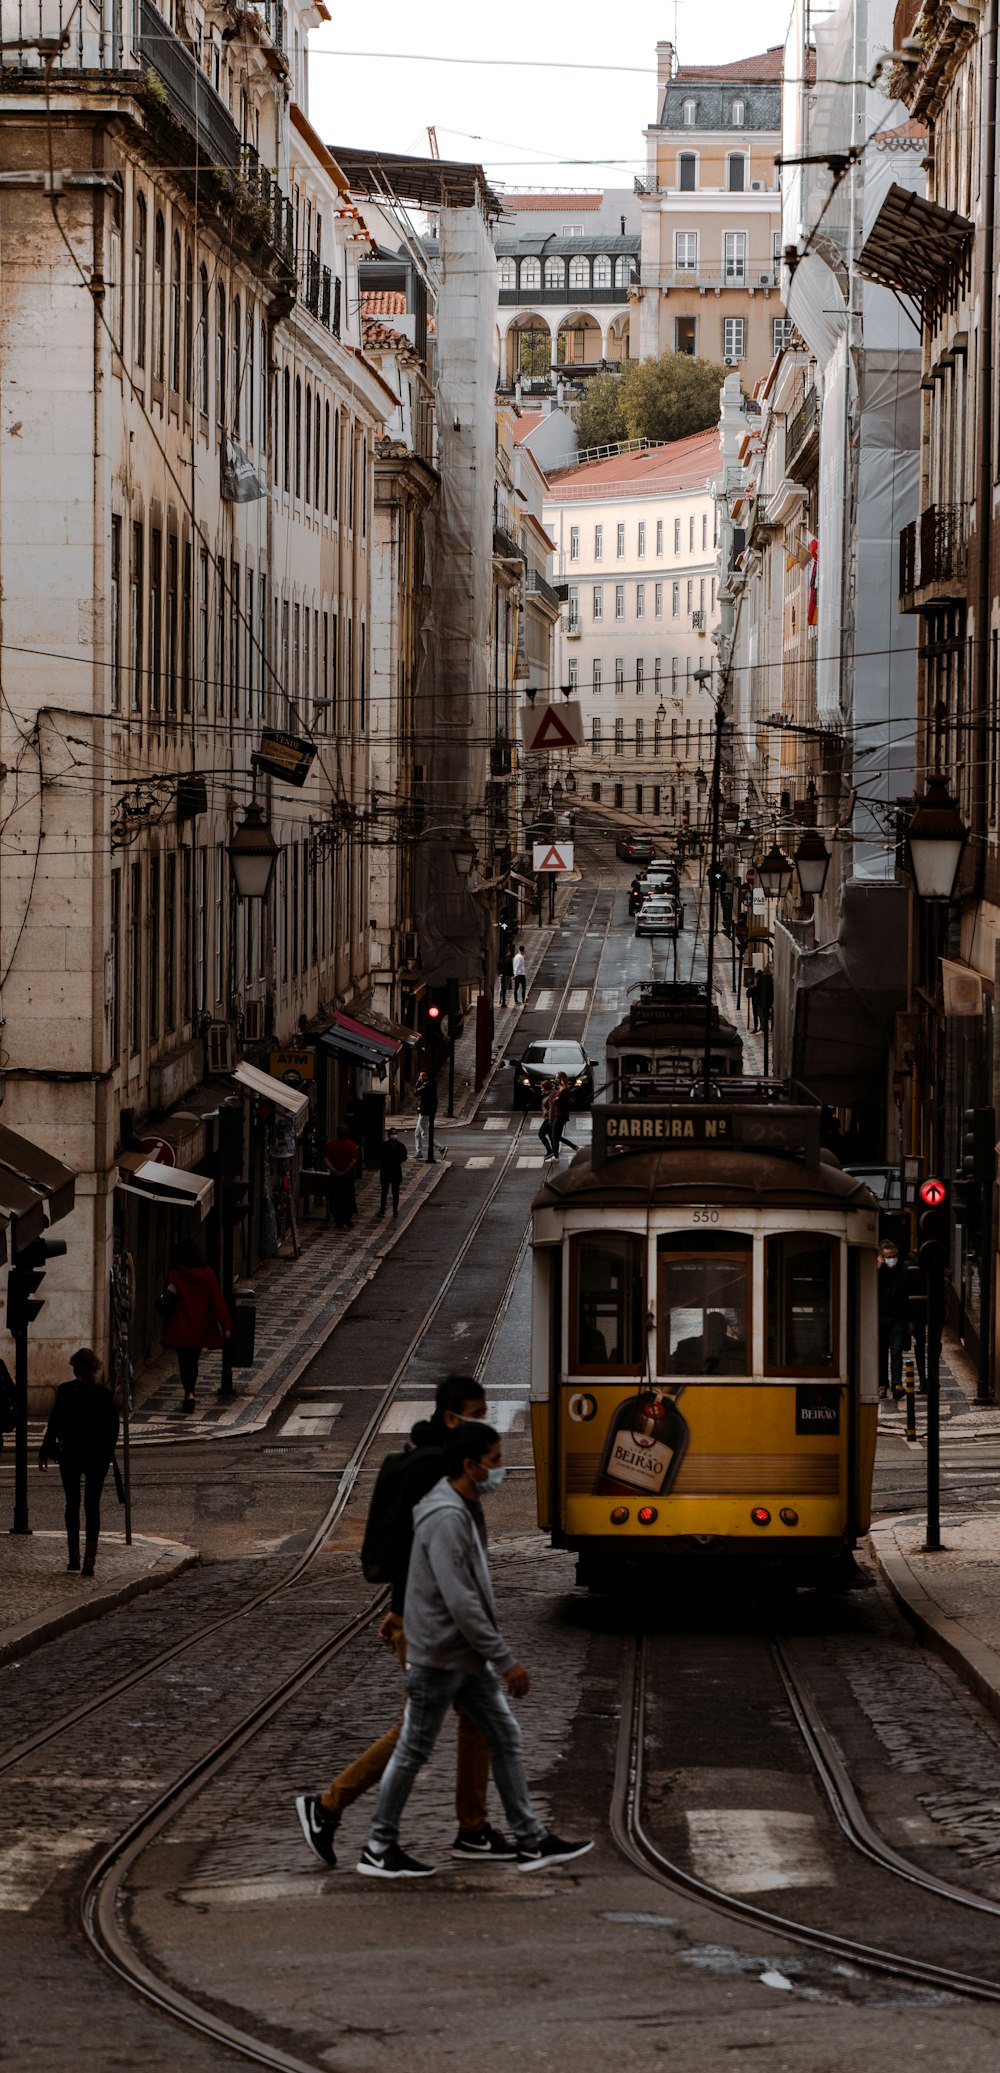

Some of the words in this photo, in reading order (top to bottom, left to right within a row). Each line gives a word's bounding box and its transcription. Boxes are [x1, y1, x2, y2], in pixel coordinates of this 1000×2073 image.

[277, 1054, 308, 1065] ATM
[606, 1118, 695, 1138] CARREIRA
[692, 1210, 719, 1223] 550
[800, 1407, 837, 1420] BEIRÃO
[614, 1446, 664, 1475] BEIRÃO
